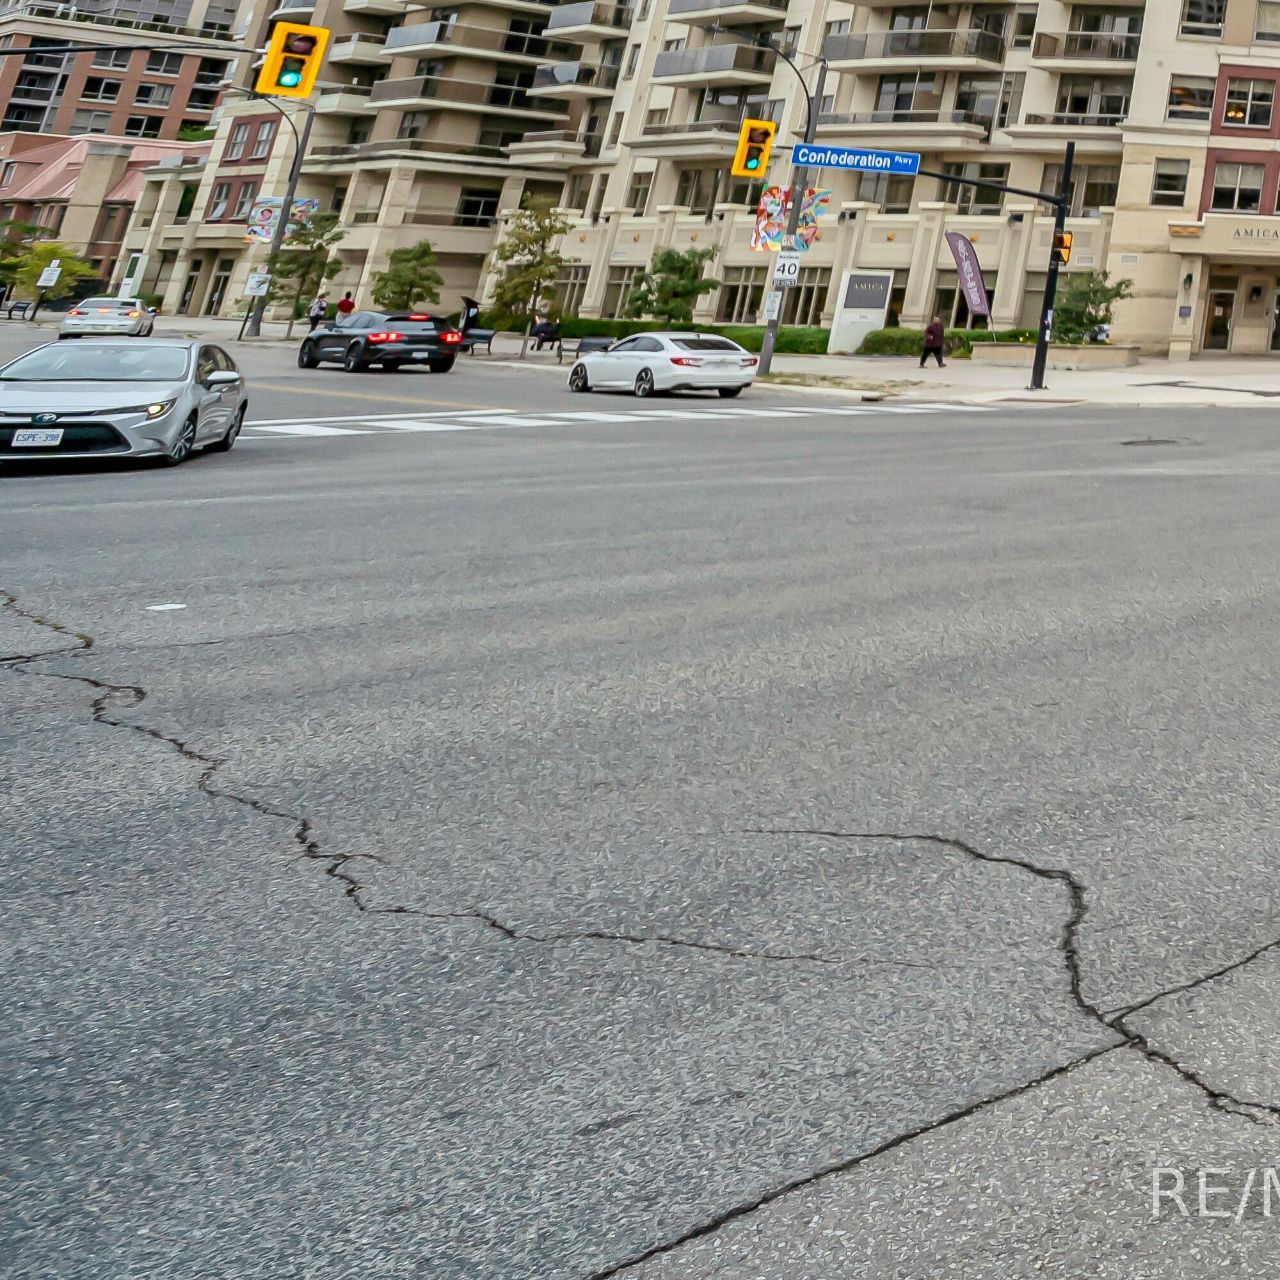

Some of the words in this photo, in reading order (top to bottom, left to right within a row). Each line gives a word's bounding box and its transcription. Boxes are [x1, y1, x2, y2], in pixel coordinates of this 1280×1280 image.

[798, 148, 891, 168] Confederation
[1233, 228, 1279, 238] AMICA
[776, 263, 797, 275] 40
[854, 282, 884, 290] AMICA
